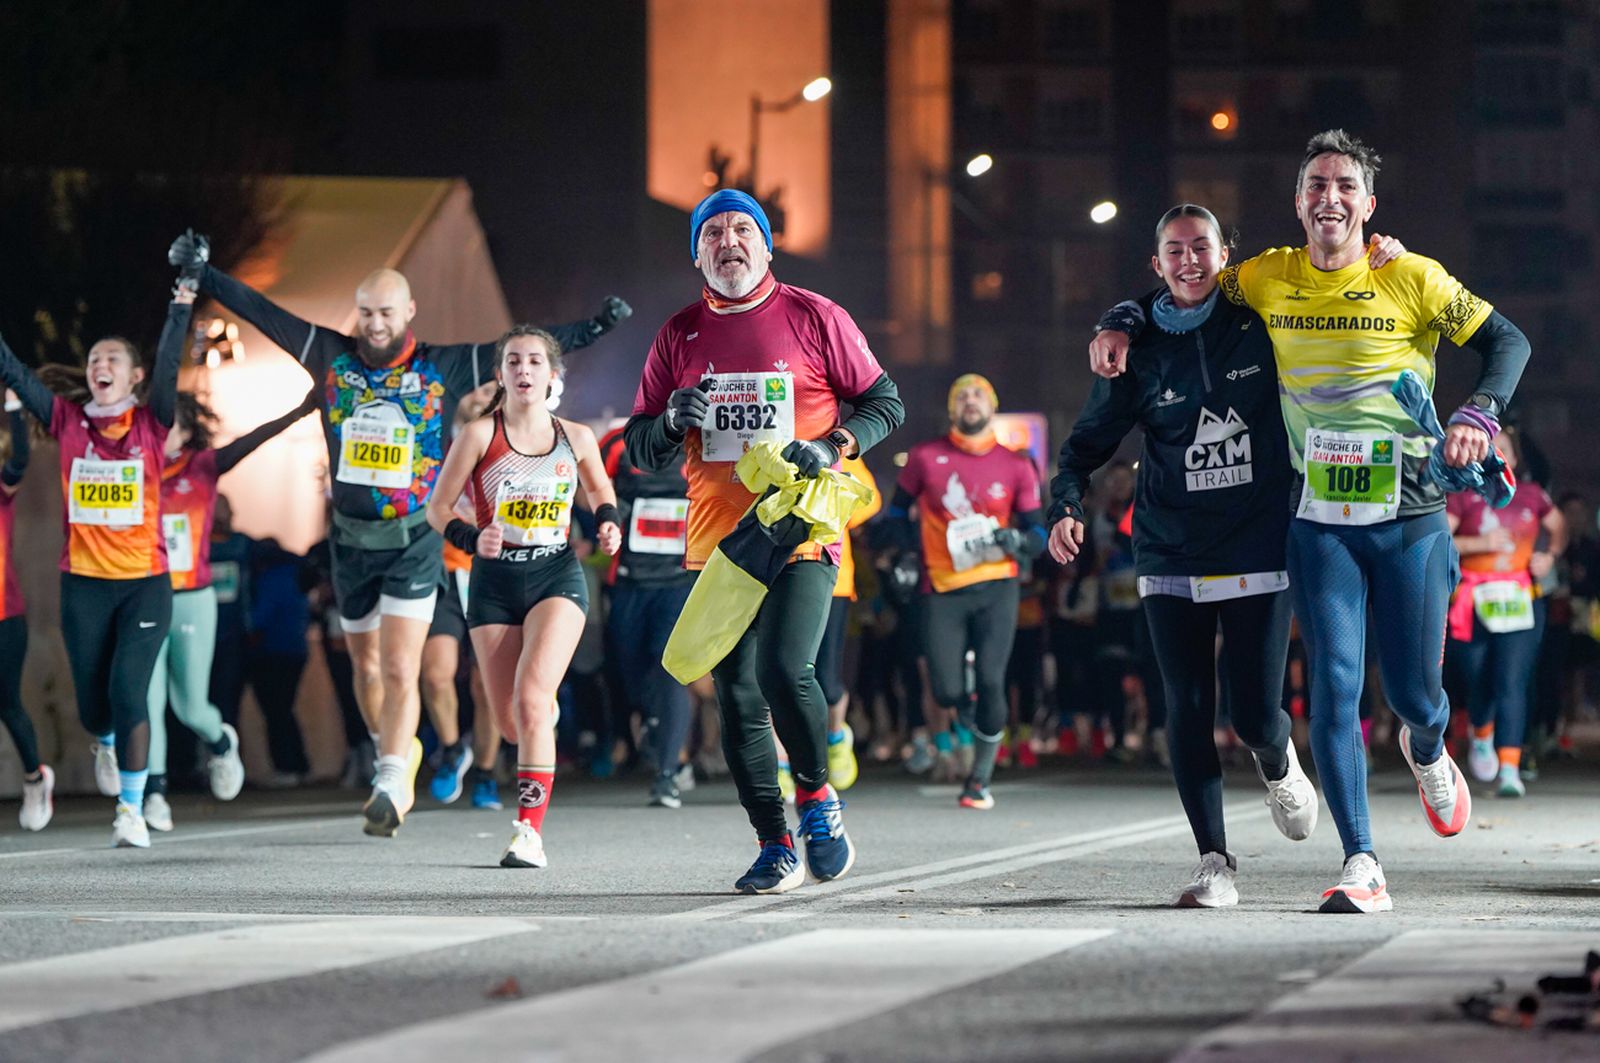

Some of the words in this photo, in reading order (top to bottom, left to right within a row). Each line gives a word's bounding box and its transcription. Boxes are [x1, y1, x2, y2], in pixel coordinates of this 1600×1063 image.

[1270, 314, 1396, 332] ENMASCARADOS
[747, 382, 757, 391] DE
[709, 394, 726, 403] SAN
[715, 404, 777, 431] 6332
[352, 443, 401, 465] 12610
[1185, 433, 1252, 470] CXM
[1312, 451, 1328, 461] SAN
[1352, 444, 1363, 453] DE
[1191, 469, 1248, 488] TRAIL
[1325, 465, 1371, 493] 108
[80, 484, 133, 502] 12085
